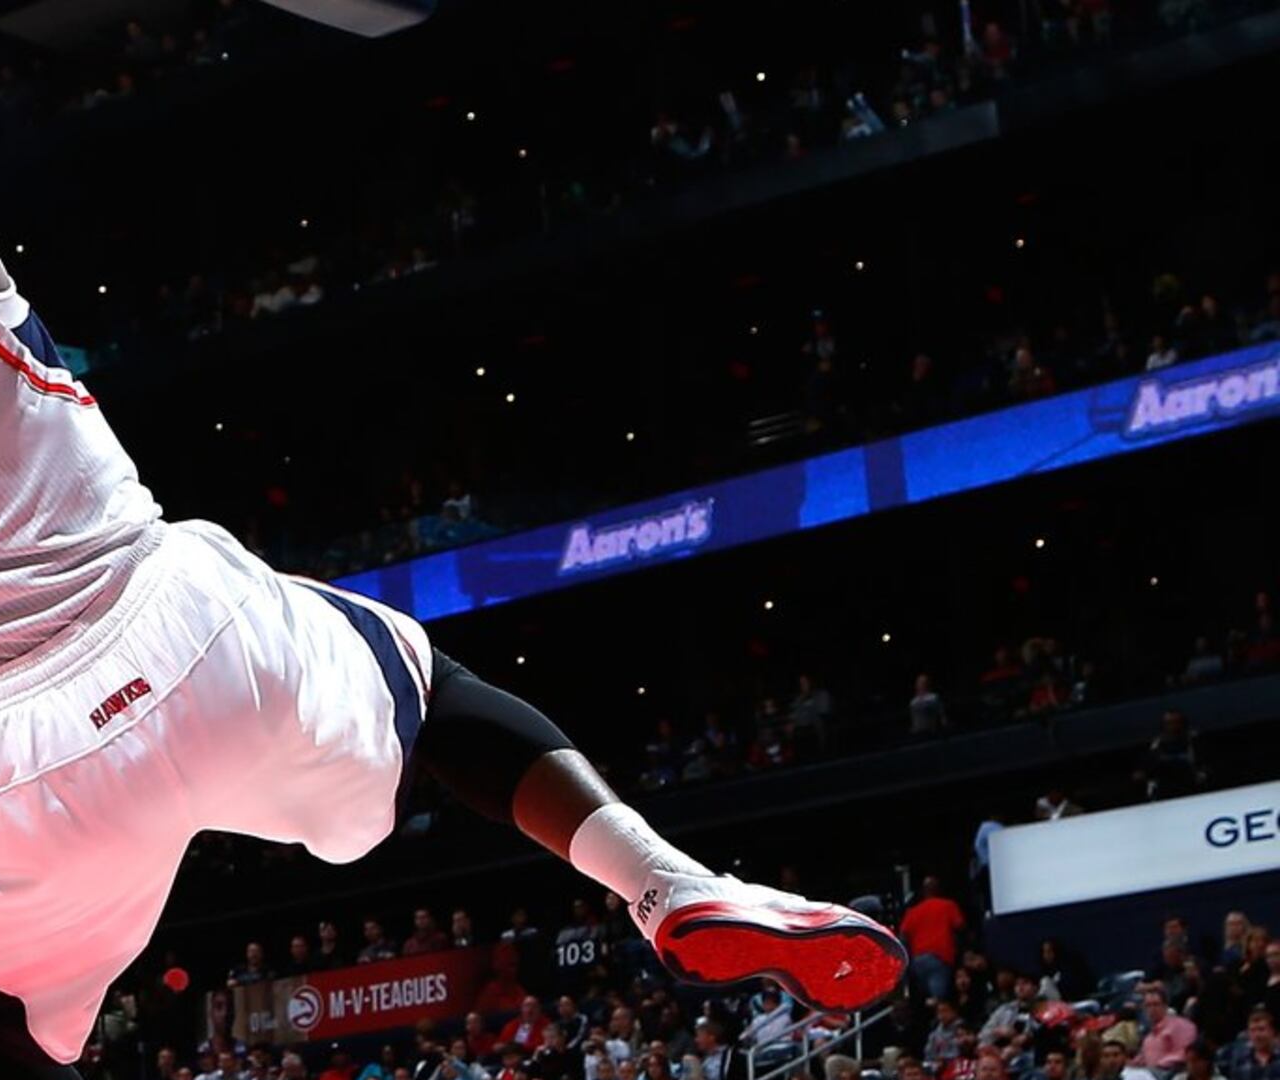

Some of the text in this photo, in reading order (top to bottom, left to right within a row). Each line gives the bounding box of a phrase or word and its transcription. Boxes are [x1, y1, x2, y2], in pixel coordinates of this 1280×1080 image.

[1128, 358, 1280, 432] Aaron
[560, 505, 710, 572] Aaron's
[1205, 808, 1280, 848] GE
[556, 940, 595, 966] 103
